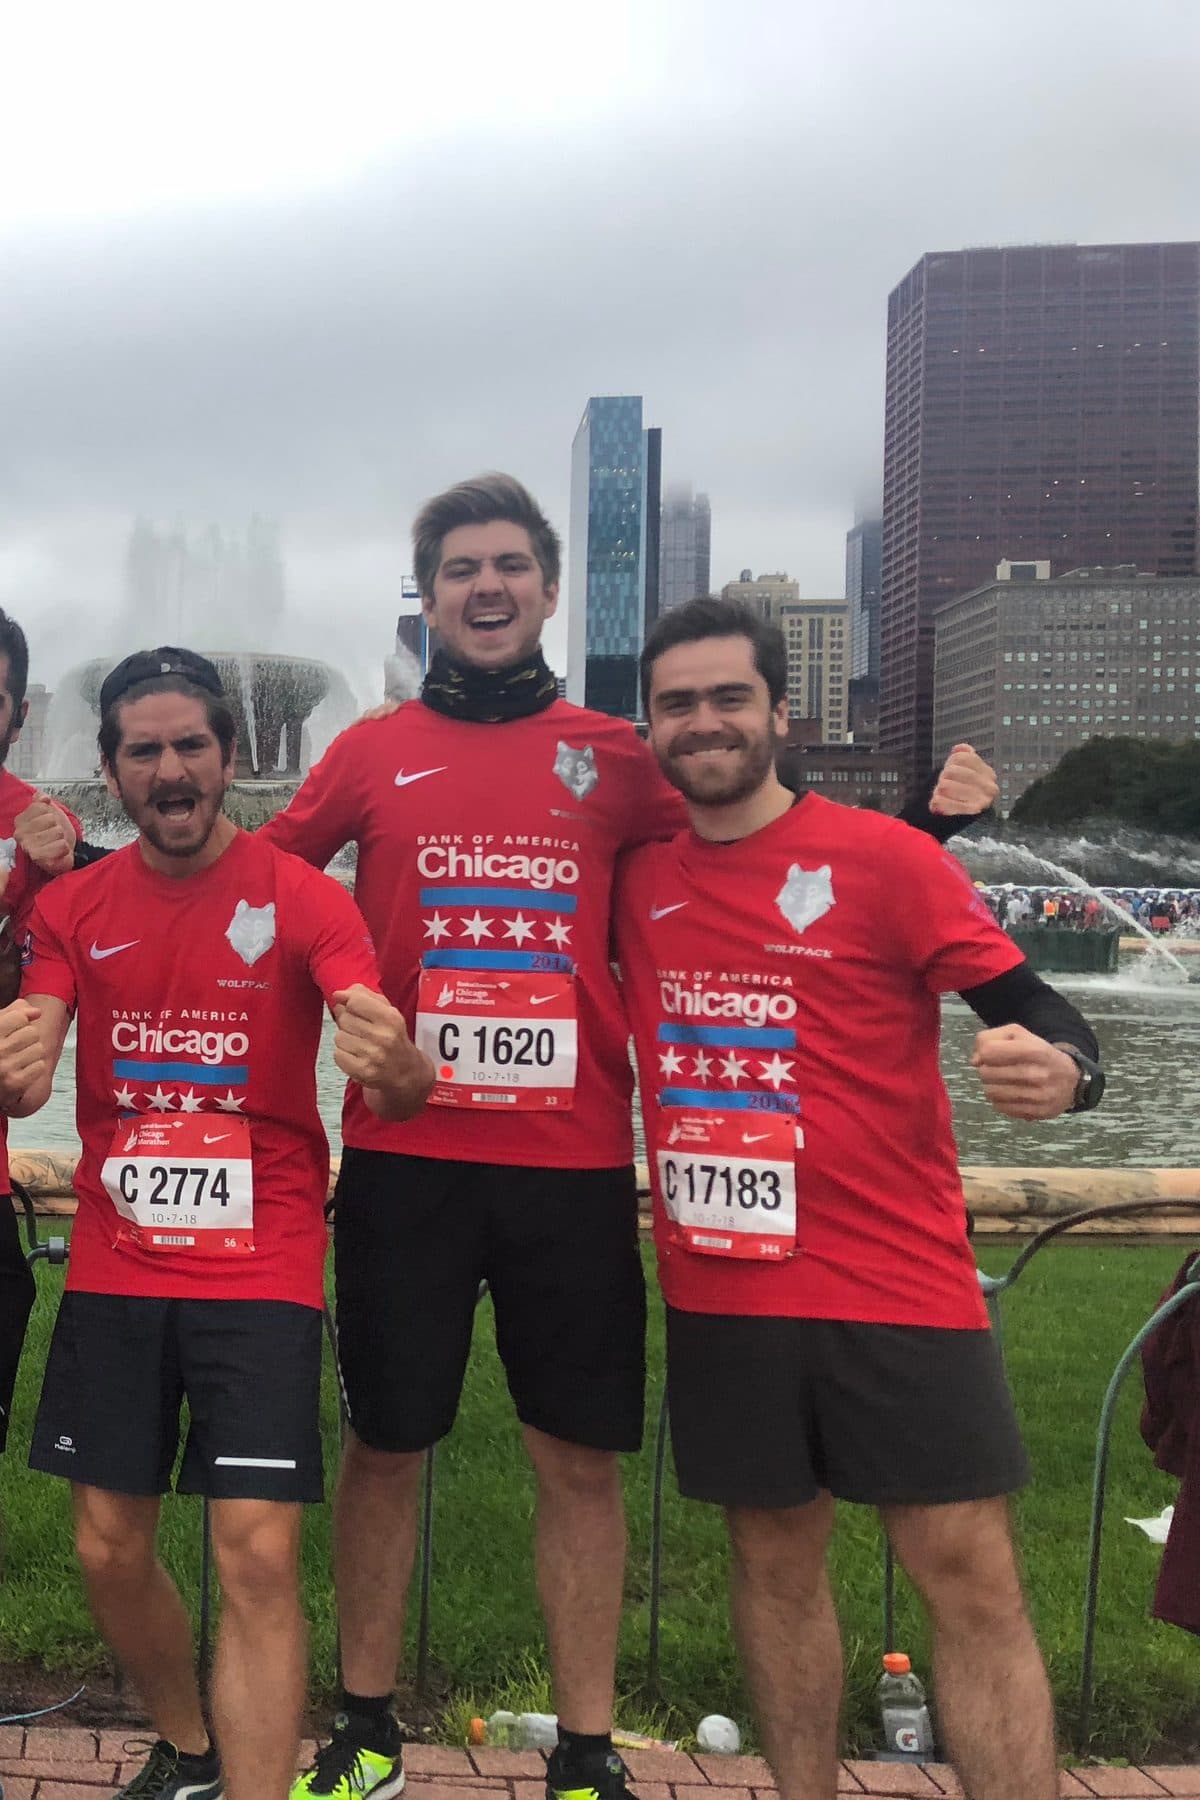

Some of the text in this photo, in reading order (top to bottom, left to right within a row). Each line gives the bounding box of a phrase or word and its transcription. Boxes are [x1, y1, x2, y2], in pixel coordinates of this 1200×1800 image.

[417, 835, 579, 851] BANK OF AMERICA
[417, 846, 579, 889] Chicago
[764, 944, 832, 958] WOLFPACK
[657, 969, 793, 986] BANK OF AMERICA
[112, 1010, 152, 1020] BANK
[181, 1009, 248, 1021] AMERICA
[660, 981, 797, 1027] Chicago
[112, 1022, 249, 1065] Chicago
[439, 1023, 554, 1066] C 1620
[120, 1164, 230, 1206] C 2774
[224, 1238, 237, 1247] 56
